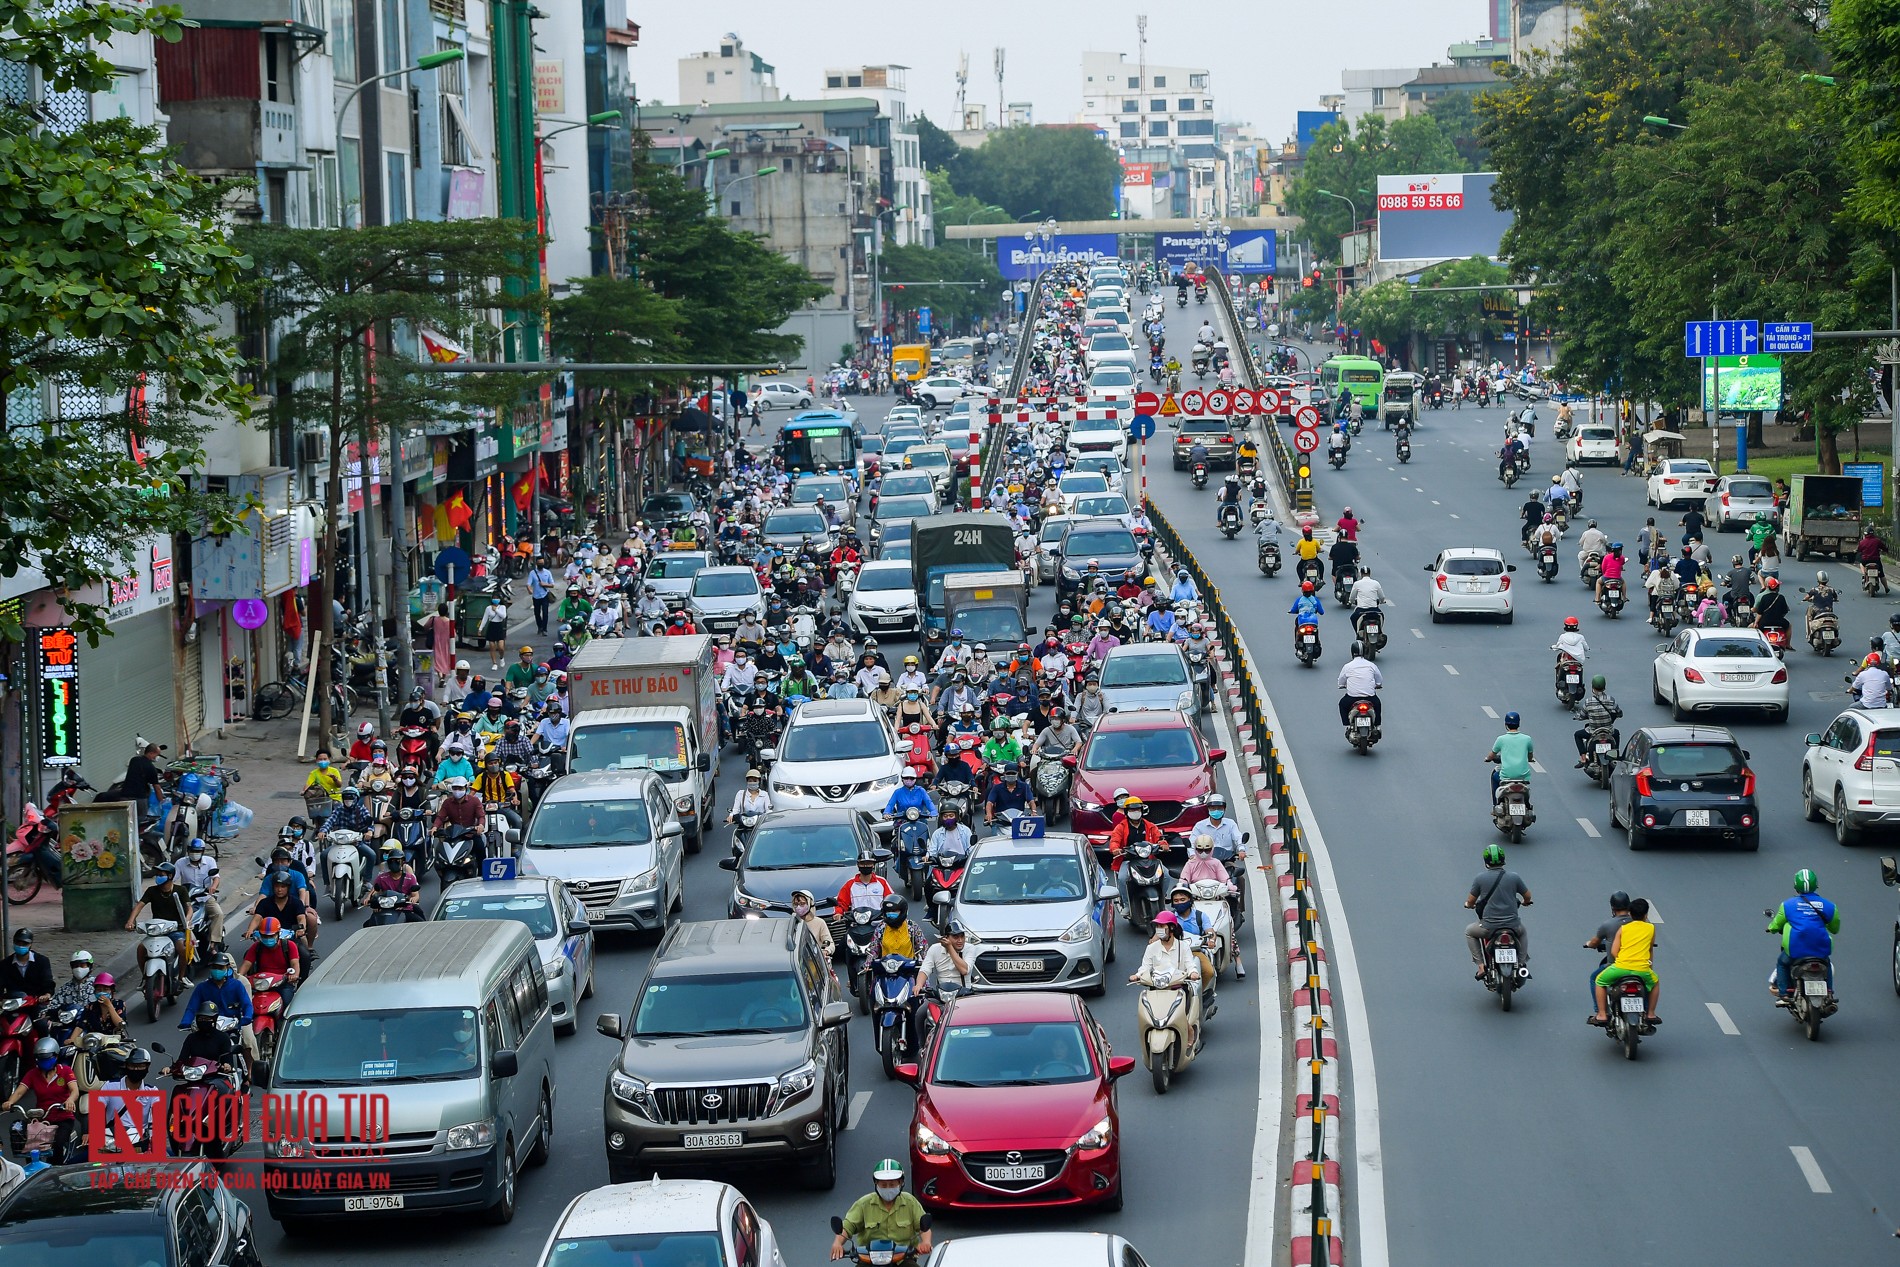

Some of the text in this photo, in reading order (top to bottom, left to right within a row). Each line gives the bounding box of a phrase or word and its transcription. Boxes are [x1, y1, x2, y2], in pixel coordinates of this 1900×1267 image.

[1380, 195, 1461, 209] 0988 59 55 66
[1011, 248, 1104, 265] Panasonic
[1775, 324, 1800, 333] CẤM XE
[1766, 332, 1776, 342] TẢI
[1776, 334, 1797, 343] TRỌNG
[1777, 342, 1790, 350] QUA
[954, 530, 982, 545] 24H
[42, 630, 75, 649] BẾP
[590, 673, 679, 696] XE THƯ BÁO
[1691, 810, 1704, 818] 30E
[1019, 820, 1037, 837] G7
[1687, 818, 1709, 826] 959.15
[490, 861, 507, 879] G7
[998, 961, 1043, 970] 30A-425.03
[685, 1134, 743, 1147] 30A-835.63
[986, 1168, 1044, 1179] 30G-191.26
[348, 1196, 400, 1210] 30L-9764
